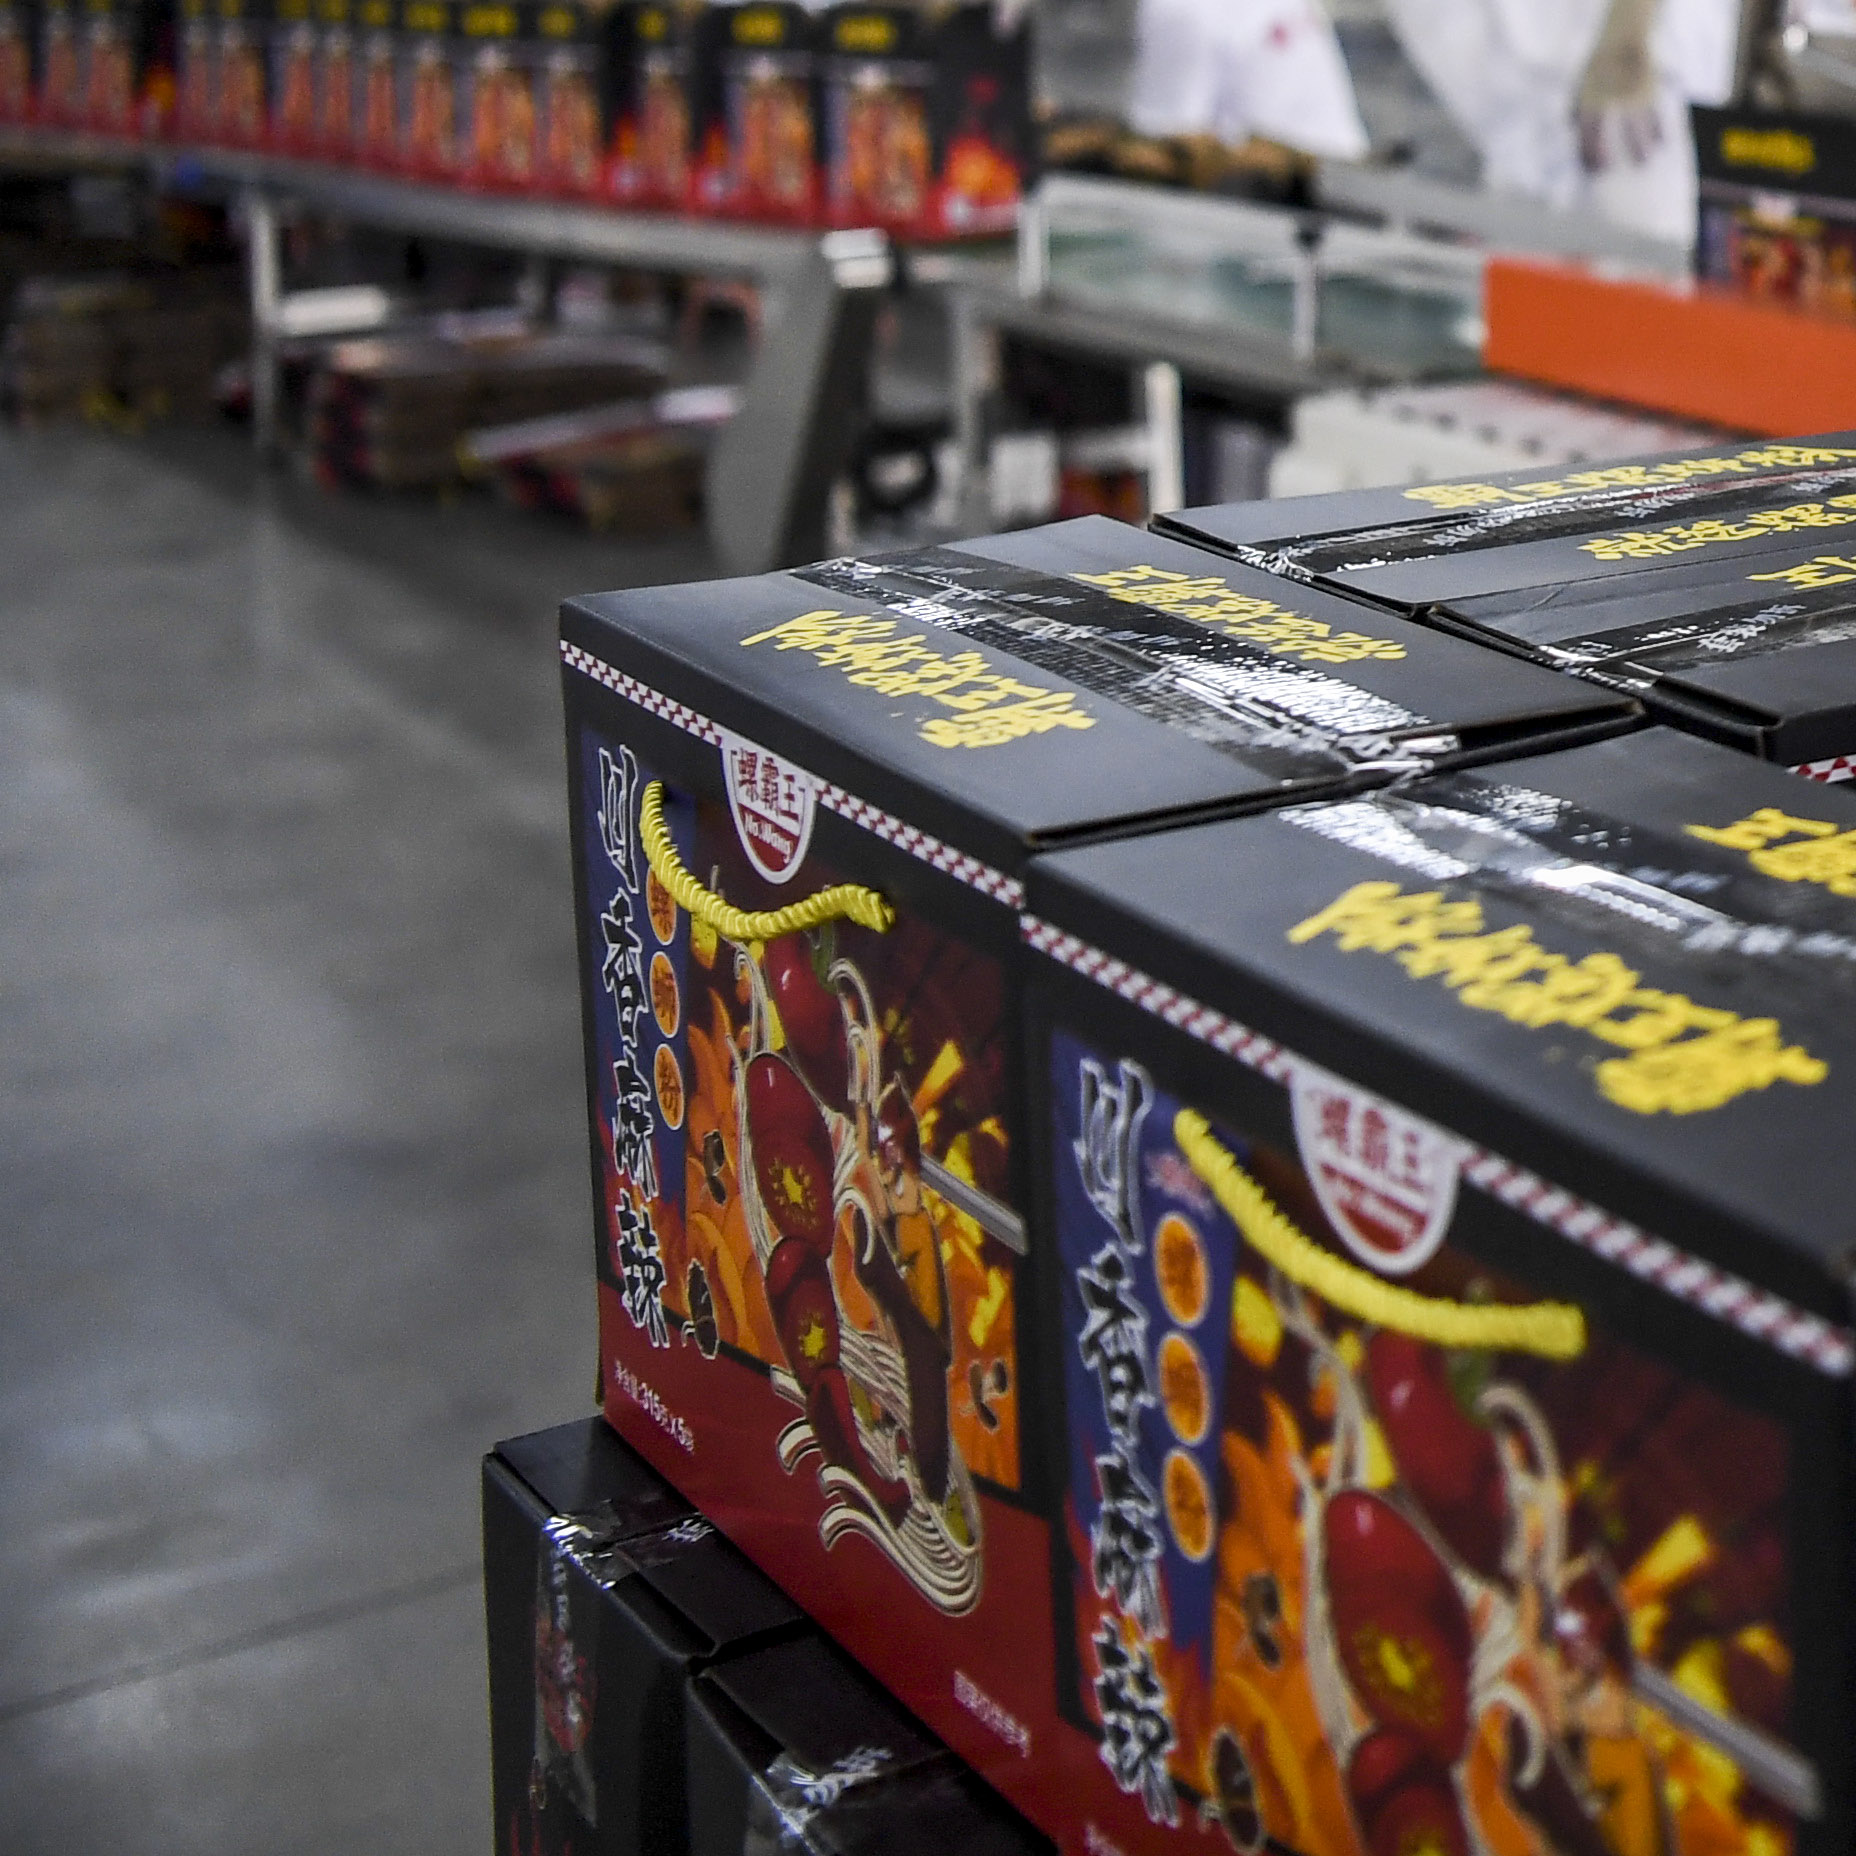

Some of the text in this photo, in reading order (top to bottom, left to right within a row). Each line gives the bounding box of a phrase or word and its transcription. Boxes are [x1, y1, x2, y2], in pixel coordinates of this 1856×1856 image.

[597, 744, 668, 1347] 川香麻辣
[1073, 1057, 1181, 1827] 川香麻辣
